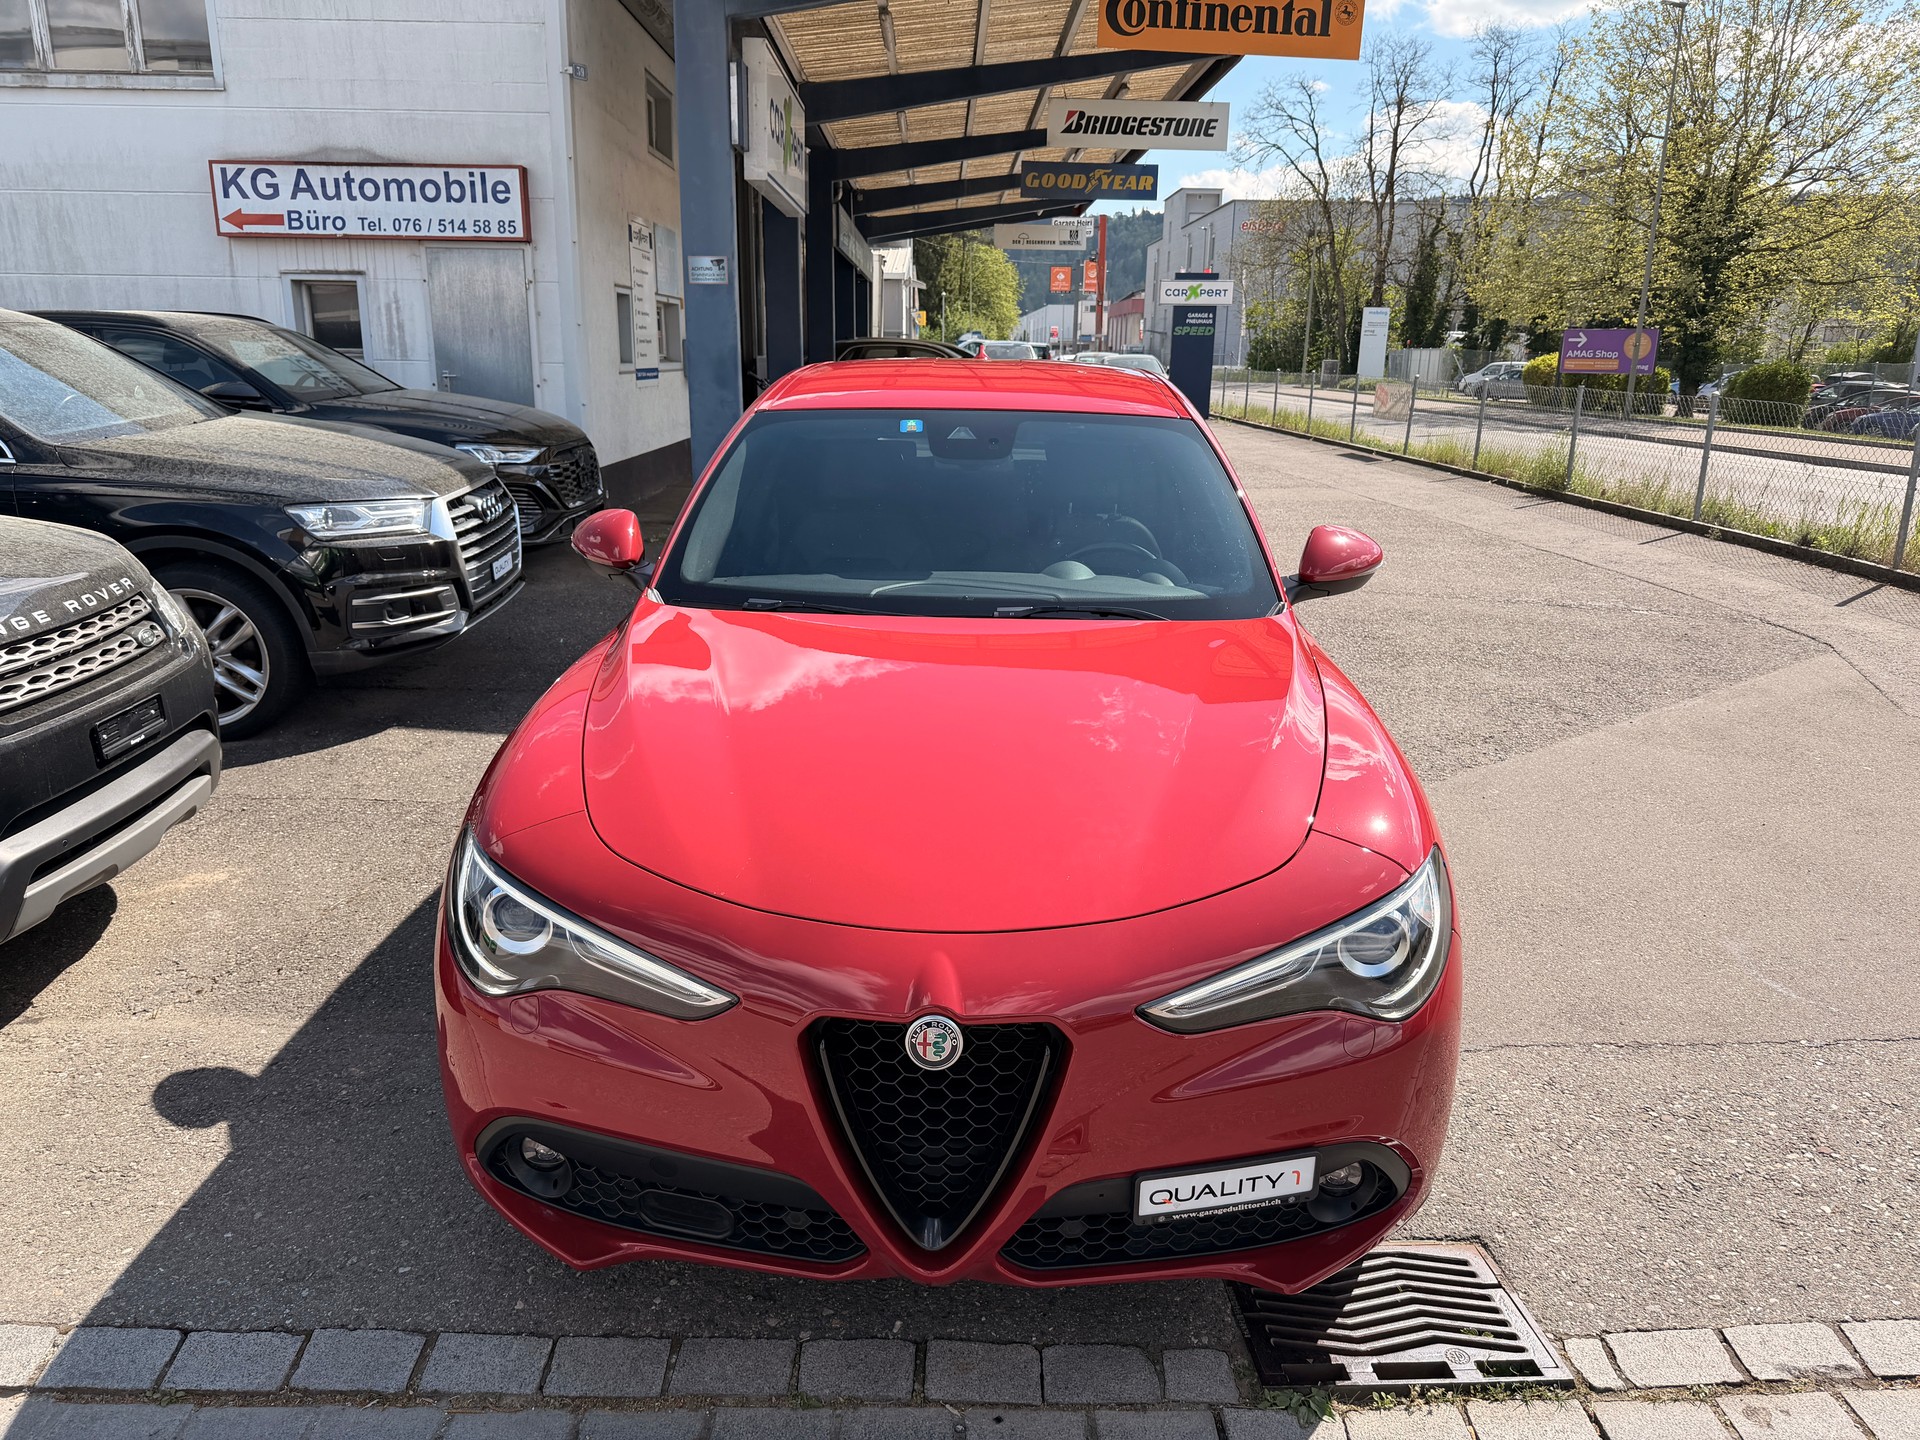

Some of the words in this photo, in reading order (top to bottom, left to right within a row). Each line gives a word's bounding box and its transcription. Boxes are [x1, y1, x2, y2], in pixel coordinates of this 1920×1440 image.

[1105, 0, 1331, 37] Continental
[1061, 110, 1219, 138] BRIDGESTONE
[220, 167, 280, 200] KG
[290, 168, 511, 204] Automobile
[287, 209, 346, 231] Büro
[357, 217, 386, 232] Tel.
[392, 217, 422, 233] 076
[427, 217, 432, 233] /
[437, 218, 467, 234] 514
[473, 219, 491, 234] 58
[497, 219, 517, 235] 85
[1173, 327, 1214, 336] SPEED
[1566, 350, 1593, 358] AMAG
[1595, 350, 1619, 360] Shop
[63, 577, 135, 613] ROVER
[911, 1024, 928, 1044] ALFA
[931, 1021, 957, 1046] ROMEO
[1150, 1172, 1285, 1206] QUALITY
[1292, 1170, 1301, 1186] 1
[1172, 1198, 1281, 1220] www.garagedulittoral.ch
